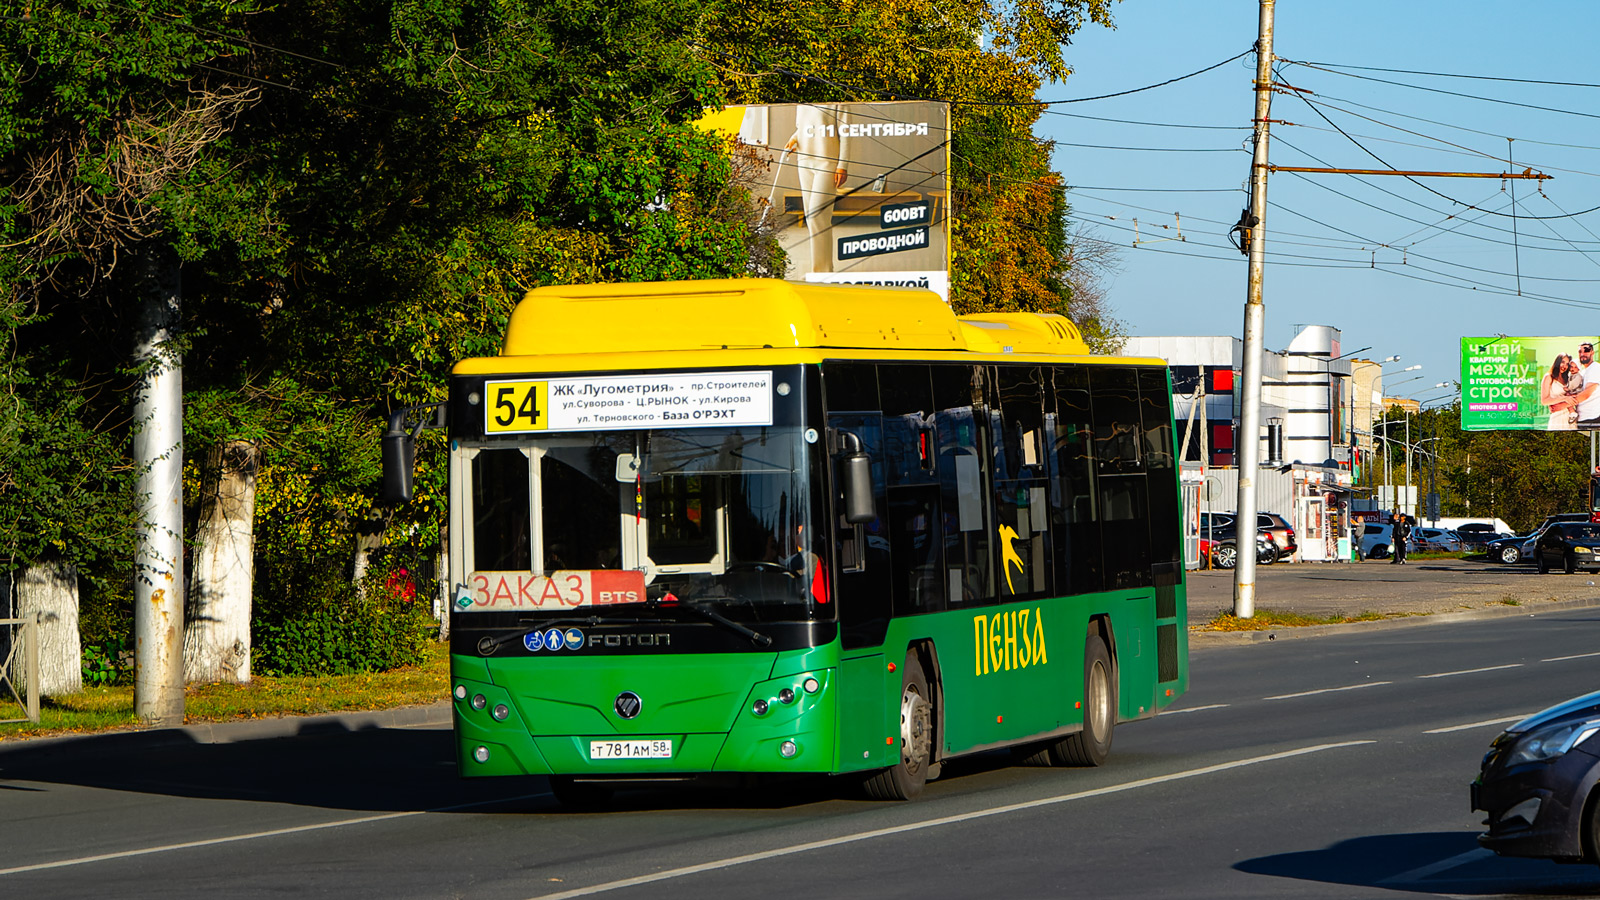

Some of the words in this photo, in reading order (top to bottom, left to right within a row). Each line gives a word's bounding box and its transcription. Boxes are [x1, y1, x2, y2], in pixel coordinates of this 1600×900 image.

[804, 124, 815, 138] С
[818, 124, 835, 138] 11
[838, 122, 928, 137] СЕНТЯБРЯ
[884, 206, 927, 224] 600ВТ
[842, 229, 925, 255] ПРОВОДНОЙ
[1469, 356, 1509, 364] КВАРТИРЫ
[1469, 364, 1530, 379] между
[553, 385, 575, 396] ЖК
[691, 380, 767, 391] пр.Строителей
[1512, 377, 1535, 386] ДОМЕ
[1469, 386, 1523, 403] строк
[495, 386, 541, 426] 54
[562, 400, 625, 410] ул.Суворова
[636, 396, 689, 407] Ц.РЫНОК
[699, 396, 752, 406] ул.Кирова
[593, 413, 655, 423] Терновского
[662, 411, 690, 420] База
[473, 575, 585, 607] ЗАКАЗ
[600, 591, 638, 602] BTS
[588, 633, 671, 647] FOTON
[974, 607, 1047, 676] ПЕНЗА
